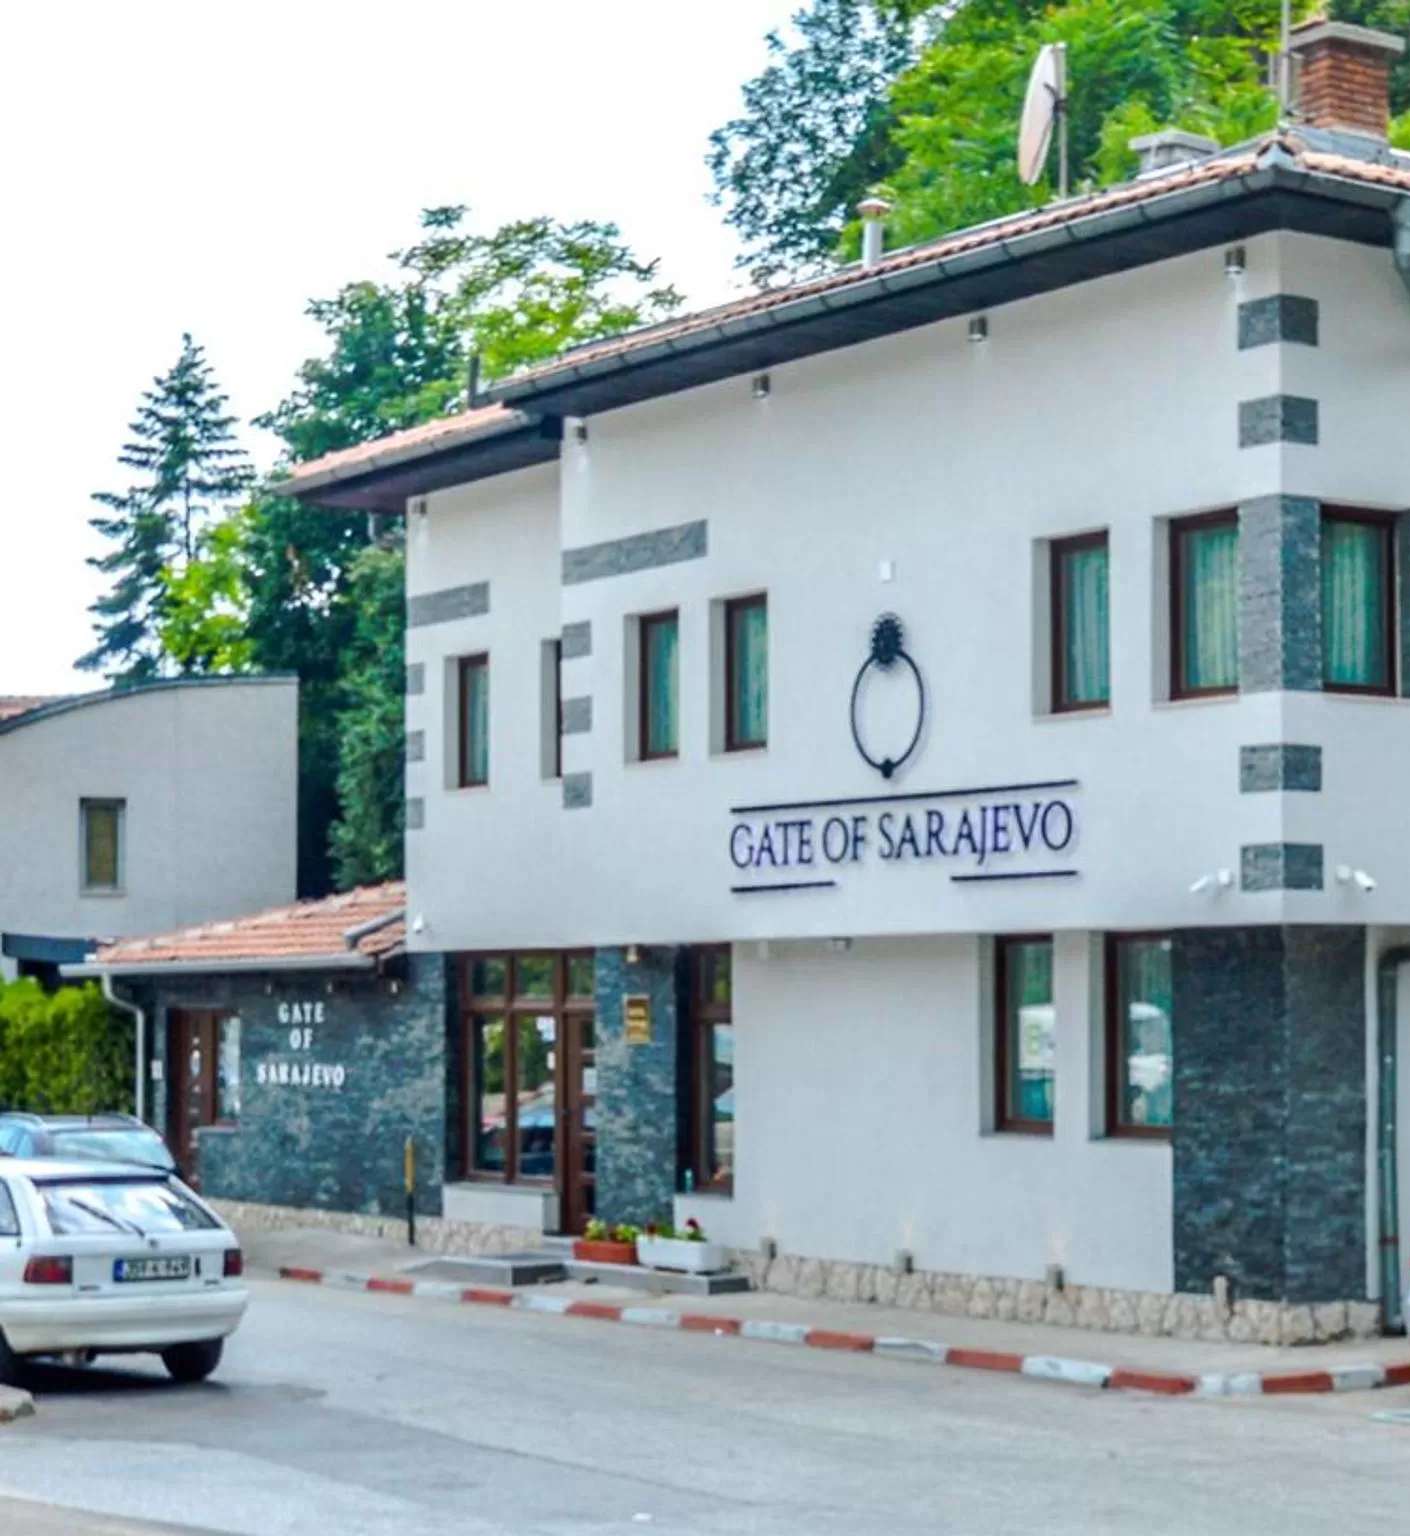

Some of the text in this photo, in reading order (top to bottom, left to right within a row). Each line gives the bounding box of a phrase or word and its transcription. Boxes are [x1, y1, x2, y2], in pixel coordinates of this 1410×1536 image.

[730, 800, 1074, 868] GATE OF SARAJEVO
[278, 1001, 325, 1024] GATE
[289, 1027, 313, 1050] OF
[257, 1063, 345, 1087] SARAJEVO
